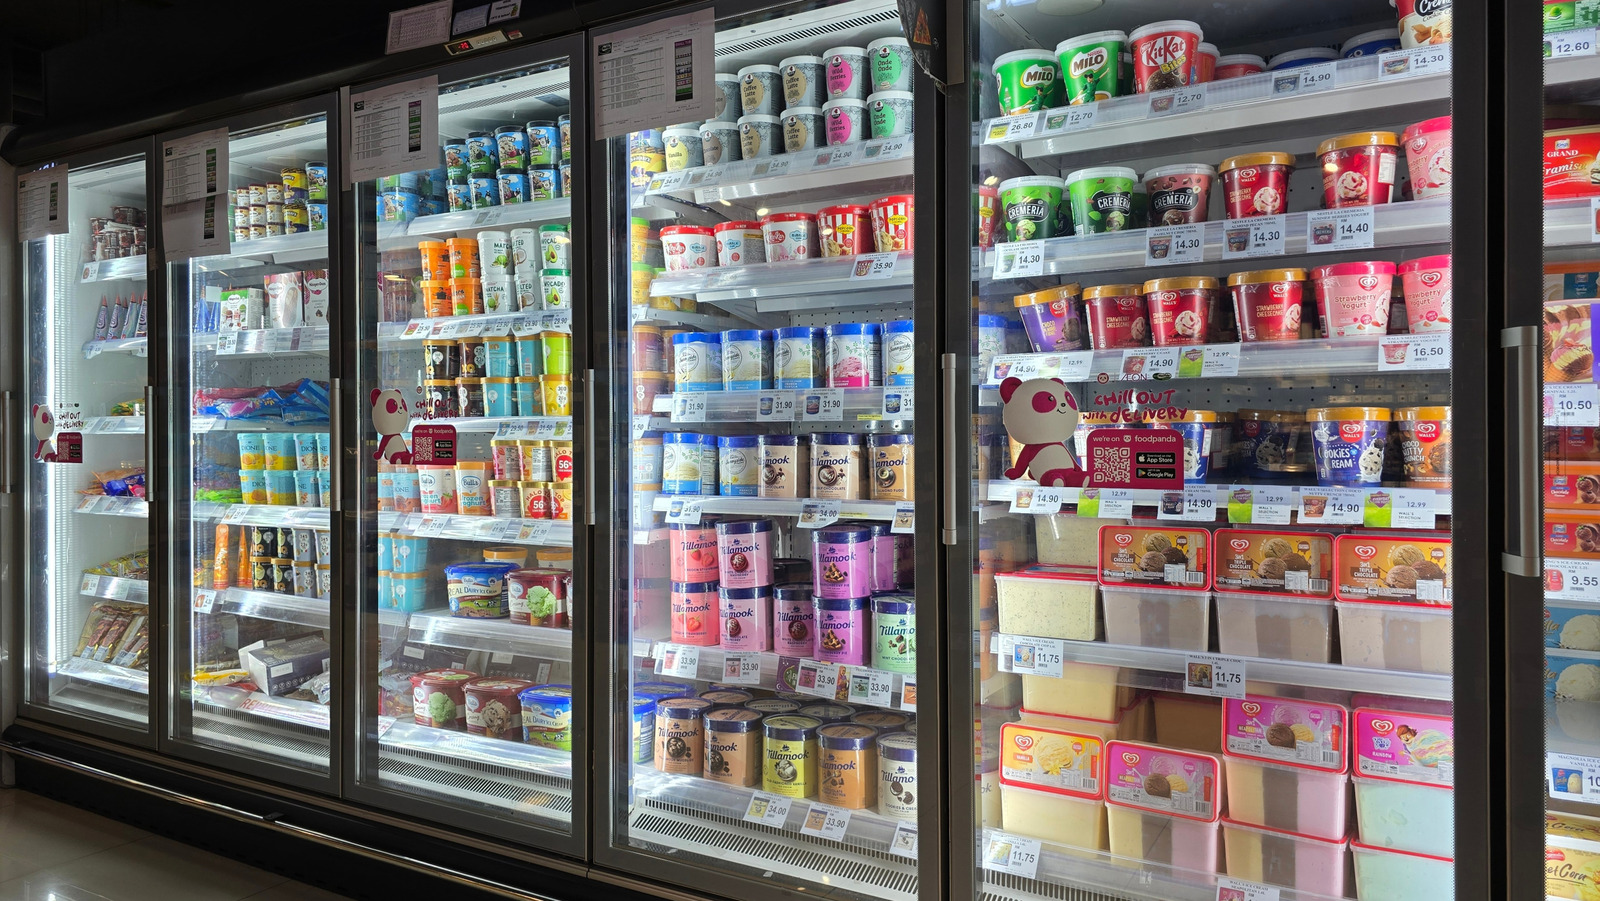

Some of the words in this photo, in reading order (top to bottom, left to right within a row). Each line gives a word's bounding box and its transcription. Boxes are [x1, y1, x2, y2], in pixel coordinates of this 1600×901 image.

[1144, 35, 1186, 67] KitKat
[1556, 42, 1590, 53] 12.60
[1073, 54, 1105, 73] MILO
[1161, 54, 1187, 74] Bites
[1414, 54, 1444, 66] 14.30
[1026, 70, 1054, 82] MILO
[1303, 73, 1331, 84] 14.90
[1176, 93, 1202, 104] 12.70
[1070, 112, 1093, 122] 12.70
[1011, 121, 1034, 132] 26.80
[883, 143, 903, 152] 34.90
[833, 152, 852, 160] 34.90
[771, 161, 789, 169] 34.90
[1544, 160, 1588, 175] ramisu
[705, 171, 722, 179] 34.90
[664, 177, 681, 185] 34.90
[1154, 194, 1193, 210] CREMERIA
[1008, 206, 1044, 218] CREMERIA
[1340, 223, 1368, 234] 14.40
[1254, 232, 1280, 242] 14.30
[1174, 239, 1200, 249] 14.30
[1018, 254, 1040, 264] 14.30
[1335, 294, 1376, 303] Strawberry
[1342, 300, 1367, 310] Yogurt
[1413, 346, 1444, 356] 16.50
[1150, 359, 1174, 368] 14.90
[1014, 364, 1036, 374] 14.90
[1136, 389, 1176, 404] OUT
[688, 403, 704, 411] 31.90
[775, 400, 792, 409] 31.90
[823, 400, 841, 408] 31.90
[1559, 400, 1592, 410] 10.50
[1082, 411, 1106, 420] with
[1135, 434, 1176, 444] foodpanda
[1403, 448, 1423, 456] NUTTY
[526, 490, 542, 502] HALO
[554, 492, 565, 503] TOP
[1037, 494, 1058, 503] 14.90
[1187, 499, 1212, 508] 14.90
[1332, 503, 1360, 512] 14.90
[819, 509, 837, 518] 34.00
[681, 540, 718, 551] Tillamoo
[1571, 576, 1598, 586] 9.55
[448, 586, 462, 596] REAL
[778, 612, 813, 621] Tillamoo
[880, 625, 915, 636] Tillamo
[680, 657, 696, 665] 33.90
[1038, 653, 1059, 664] 11.75
[742, 663, 758, 672] 33.90
[817, 674, 835, 686] 33.90
[1215, 672, 1241, 683] 11.75
[870, 683, 890, 693] 33.90
[767, 749, 809, 760] Tillamook
[881, 770, 914, 783] Tillamo
[768, 806, 786, 816] 34.00
[826, 818, 846, 828] 33.90
[1013, 851, 1034, 863] 11.75
[1560, 864, 1586, 881] Corn
